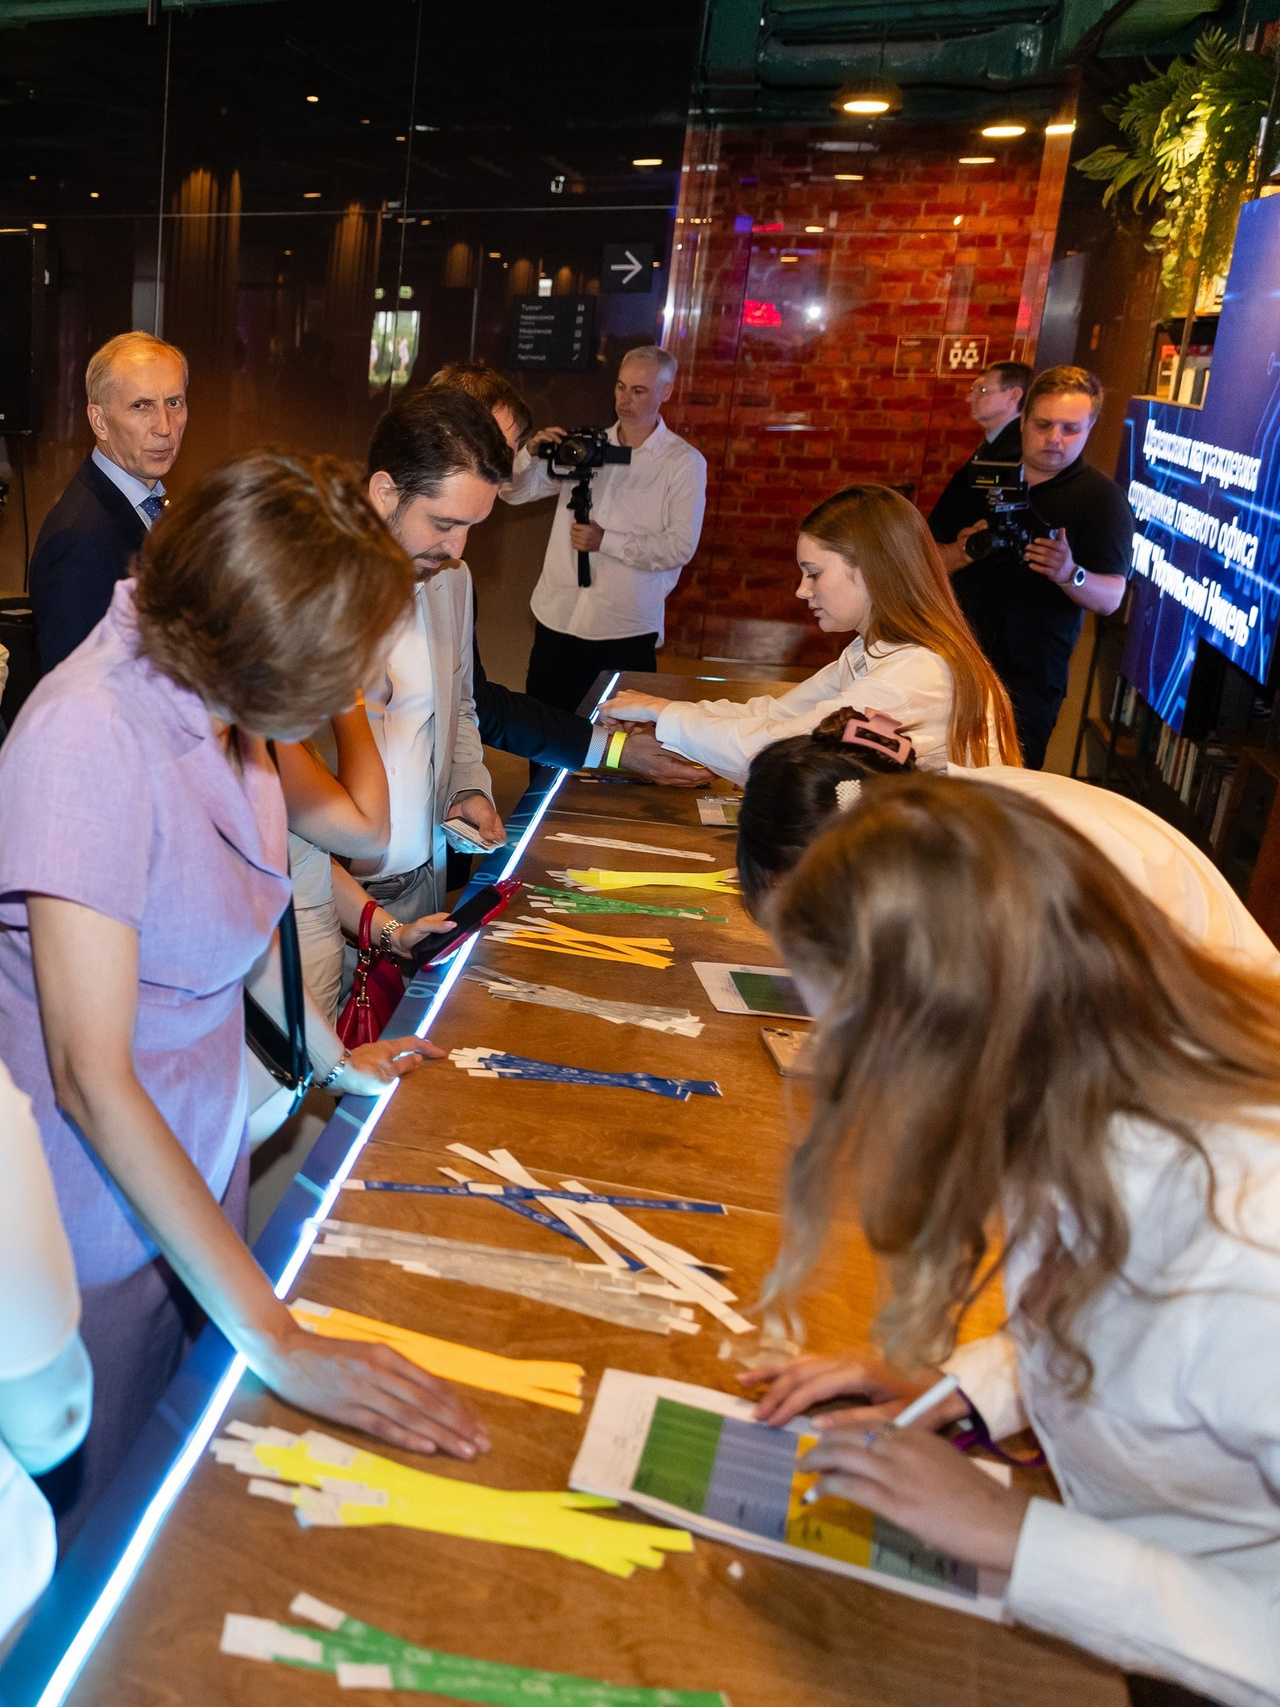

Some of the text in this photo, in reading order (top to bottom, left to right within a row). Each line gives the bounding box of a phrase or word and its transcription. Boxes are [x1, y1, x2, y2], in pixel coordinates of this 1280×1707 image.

[1143, 418, 1262, 492] Церемония награждения
[1127, 479, 1260, 570] сотрудников главного офиса
[1203, 580, 1260, 648] Никель"
